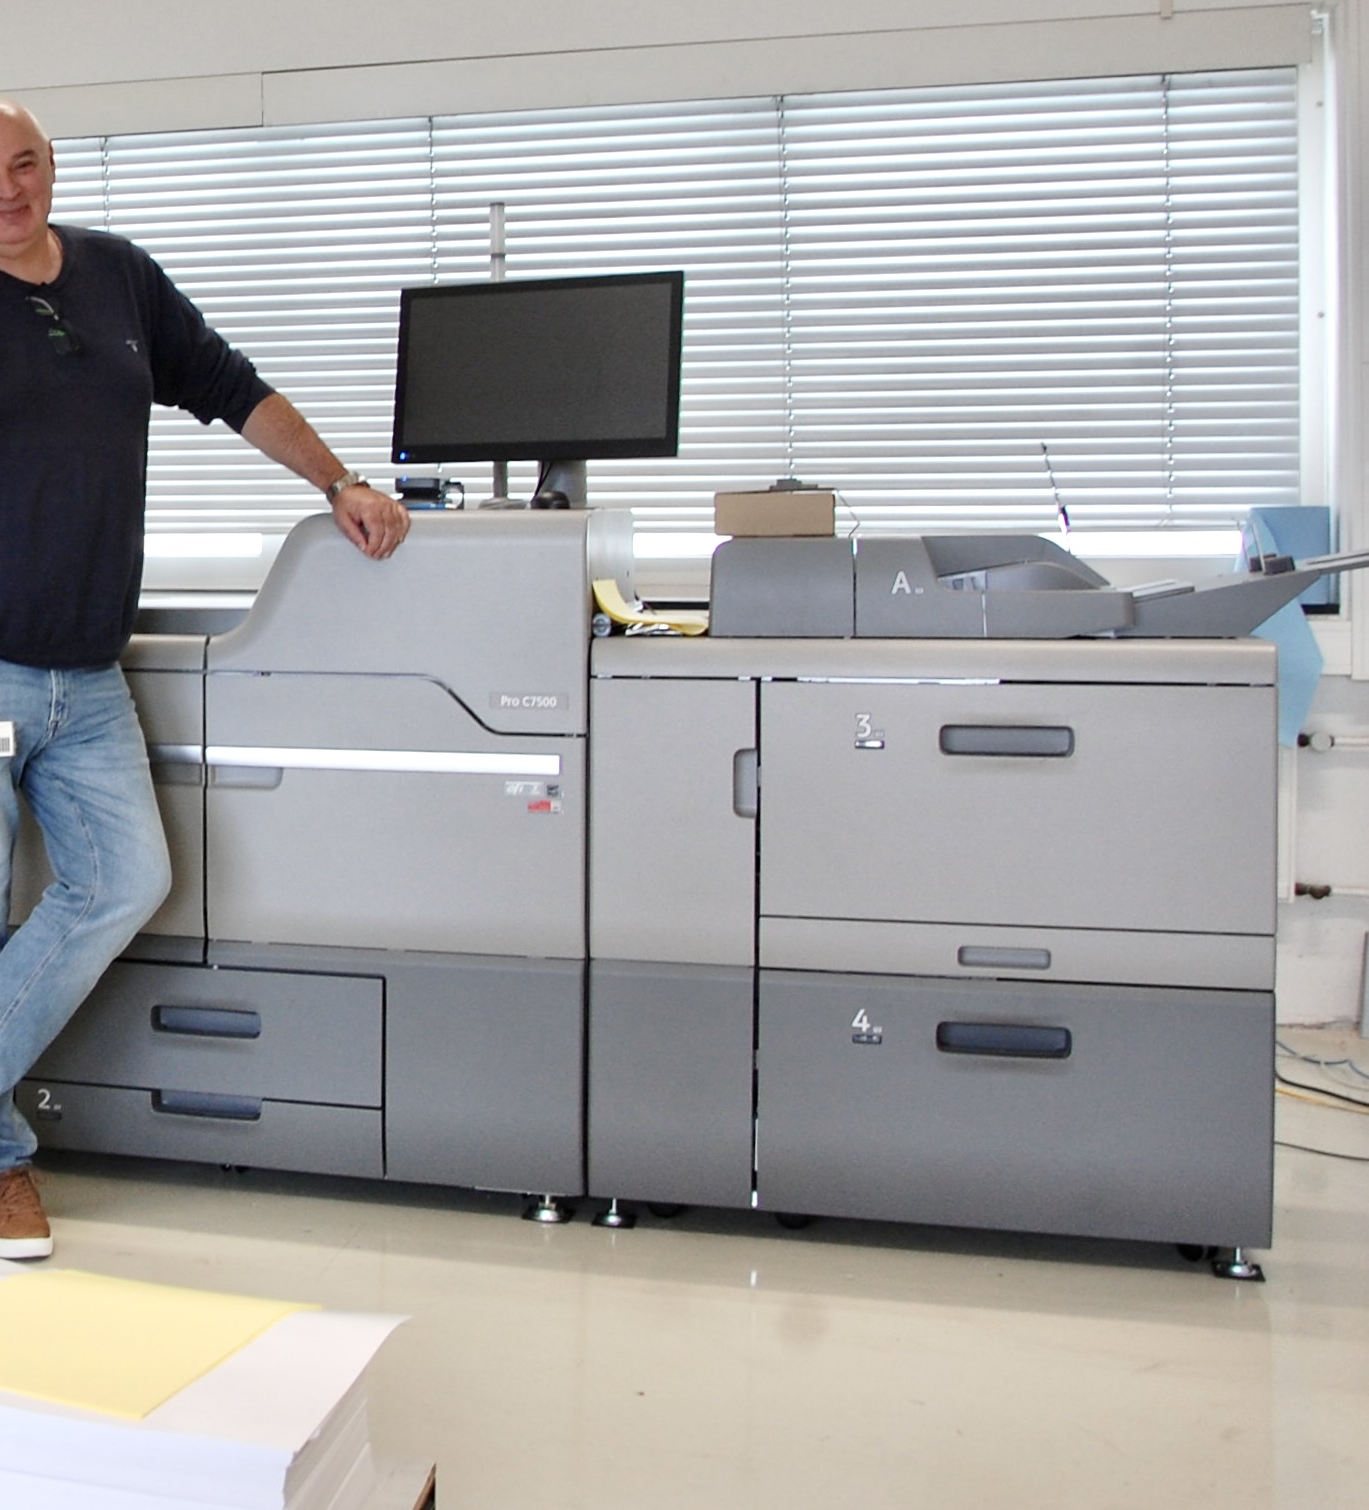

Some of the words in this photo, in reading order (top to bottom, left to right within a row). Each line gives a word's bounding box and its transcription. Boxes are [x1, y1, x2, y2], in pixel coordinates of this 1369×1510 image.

[891, 570, 911, 595] A
[500, 694, 520, 708] Pro
[522, 695, 557, 709] C7500
[856, 713, 872, 738] 3
[852, 1008, 871, 1033] 4
[37, 1088, 51, 1110] 2
